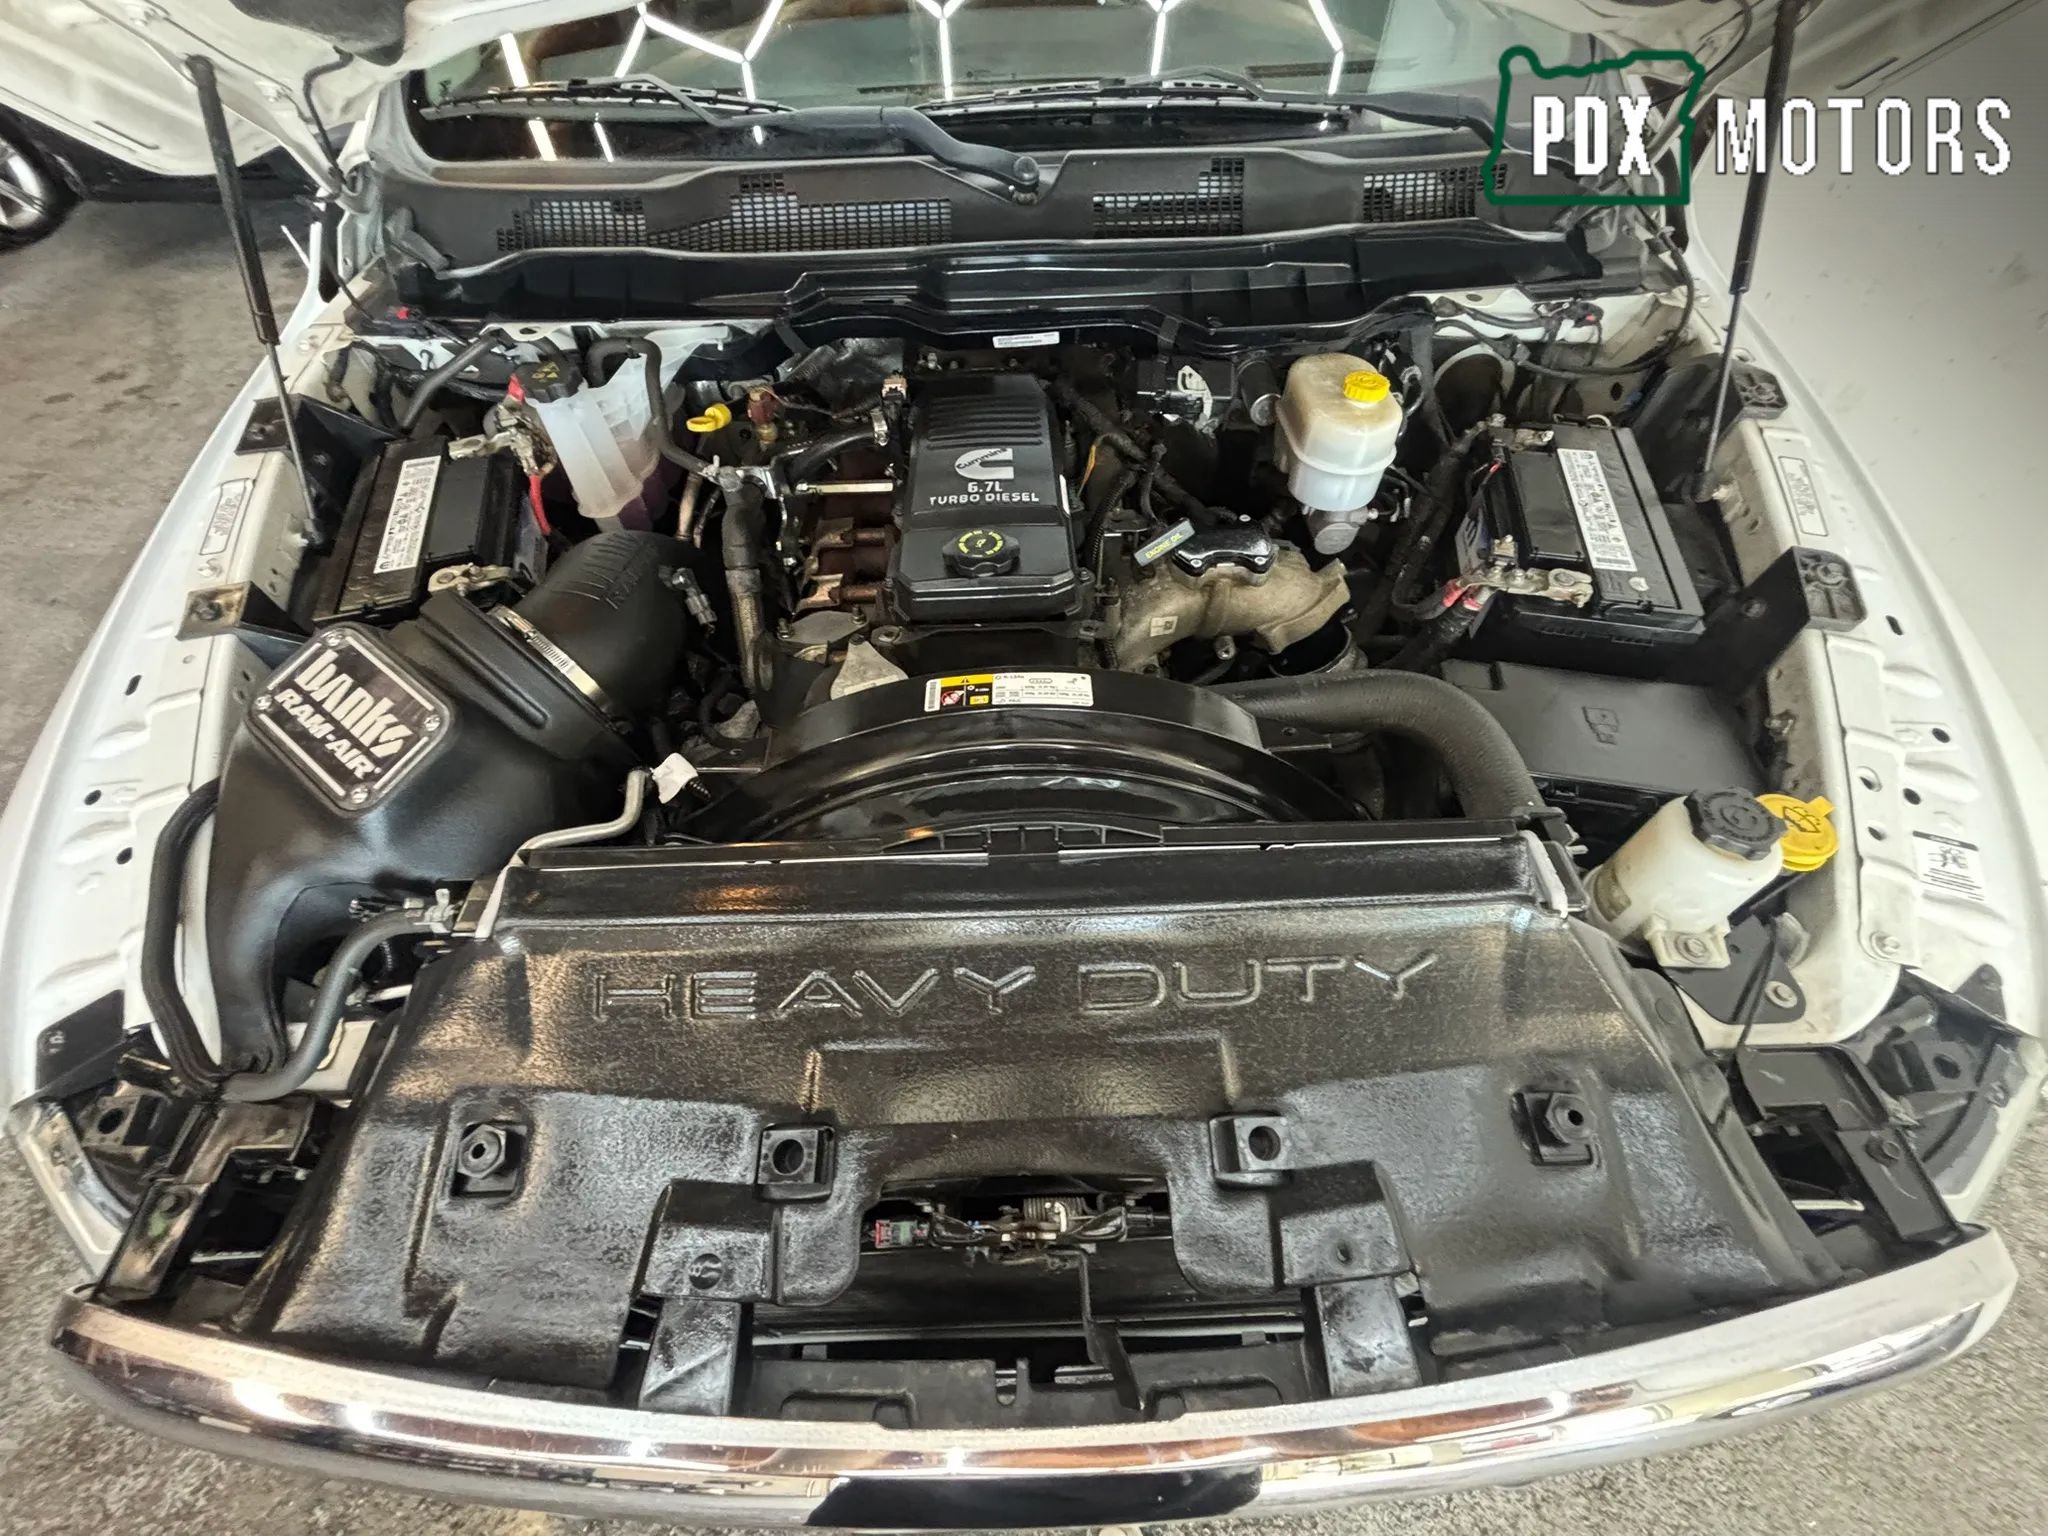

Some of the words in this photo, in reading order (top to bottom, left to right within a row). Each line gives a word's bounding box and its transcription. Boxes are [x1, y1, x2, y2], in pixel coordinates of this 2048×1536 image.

[967, 481, 1003, 493] 6.7L
[929, 494, 980, 506] TURBO
[985, 492, 1040, 502] DIESEL
[593, 965, 1037, 1021] HEAVY
[1078, 951, 1439, 1014] DUTY
